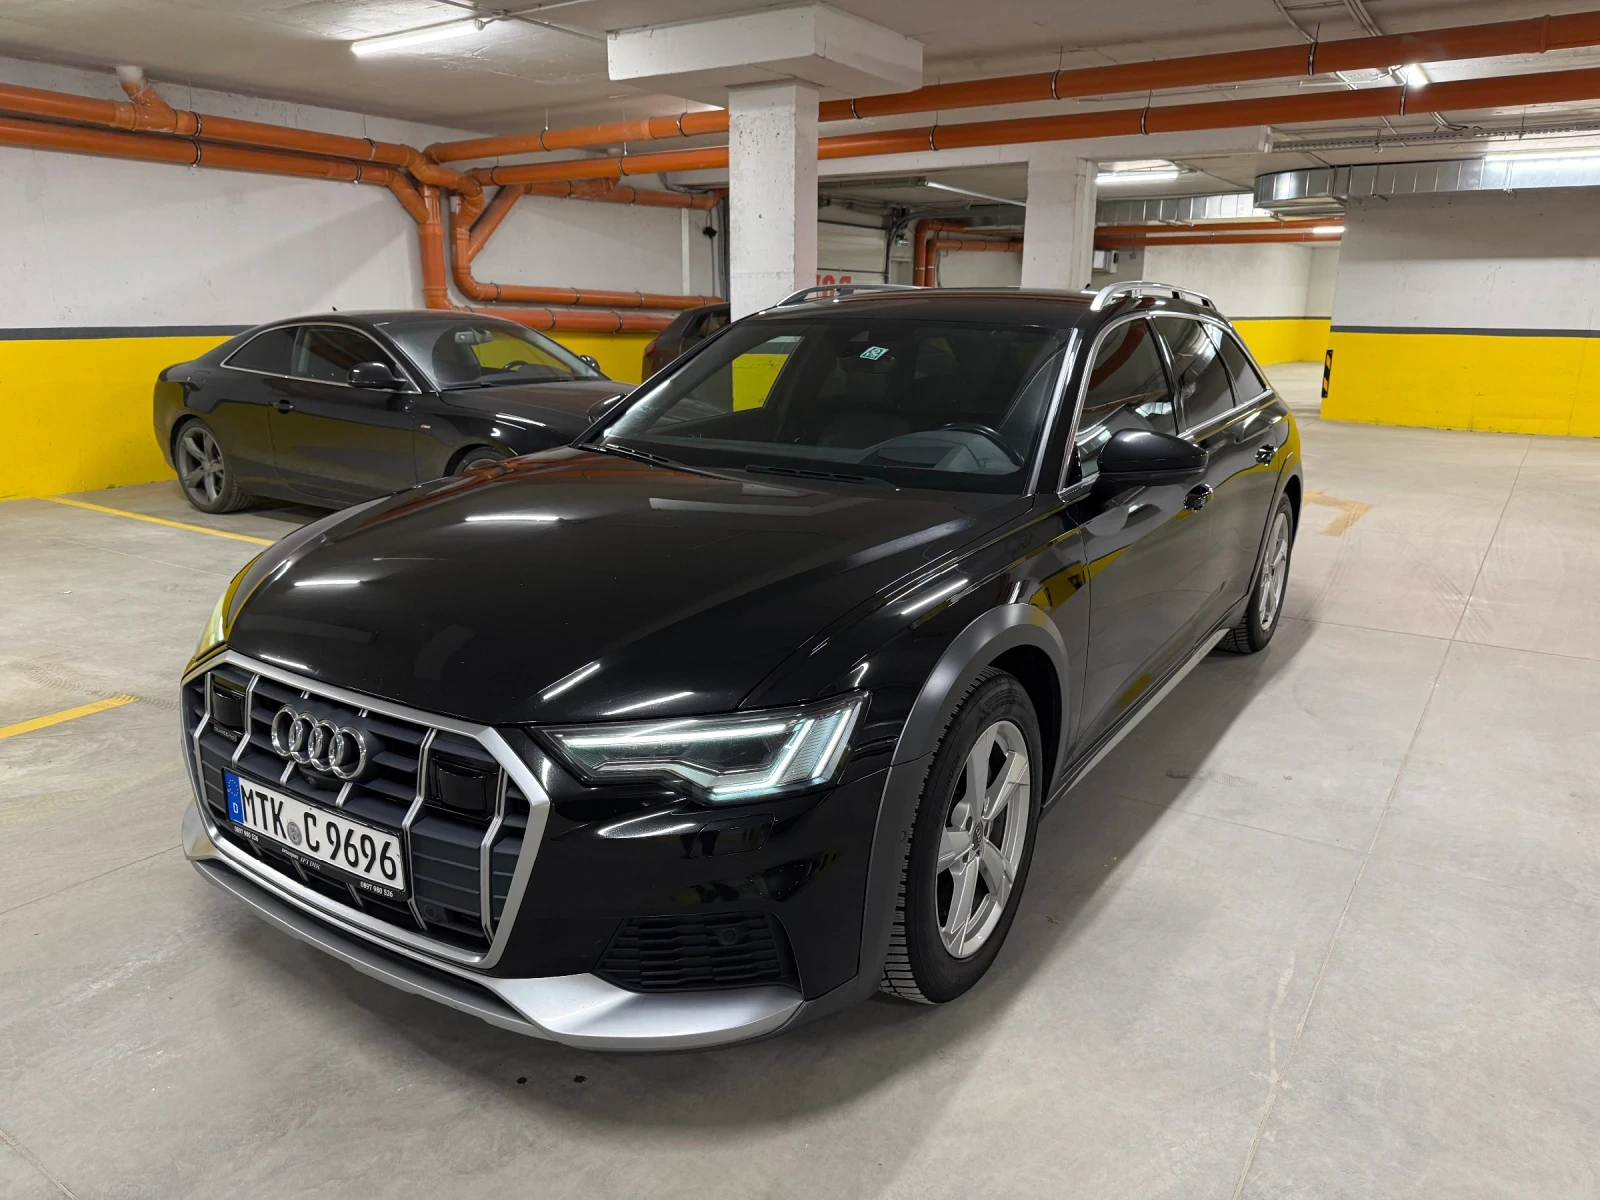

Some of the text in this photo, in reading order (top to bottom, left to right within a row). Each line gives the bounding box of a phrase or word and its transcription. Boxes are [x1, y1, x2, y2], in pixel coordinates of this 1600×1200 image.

[232, 802, 239, 814] D
[241, 785, 287, 839] MTK
[303, 811, 320, 853] C
[327, 821, 397, 881] 9696
[383, 888, 394, 898] 526
